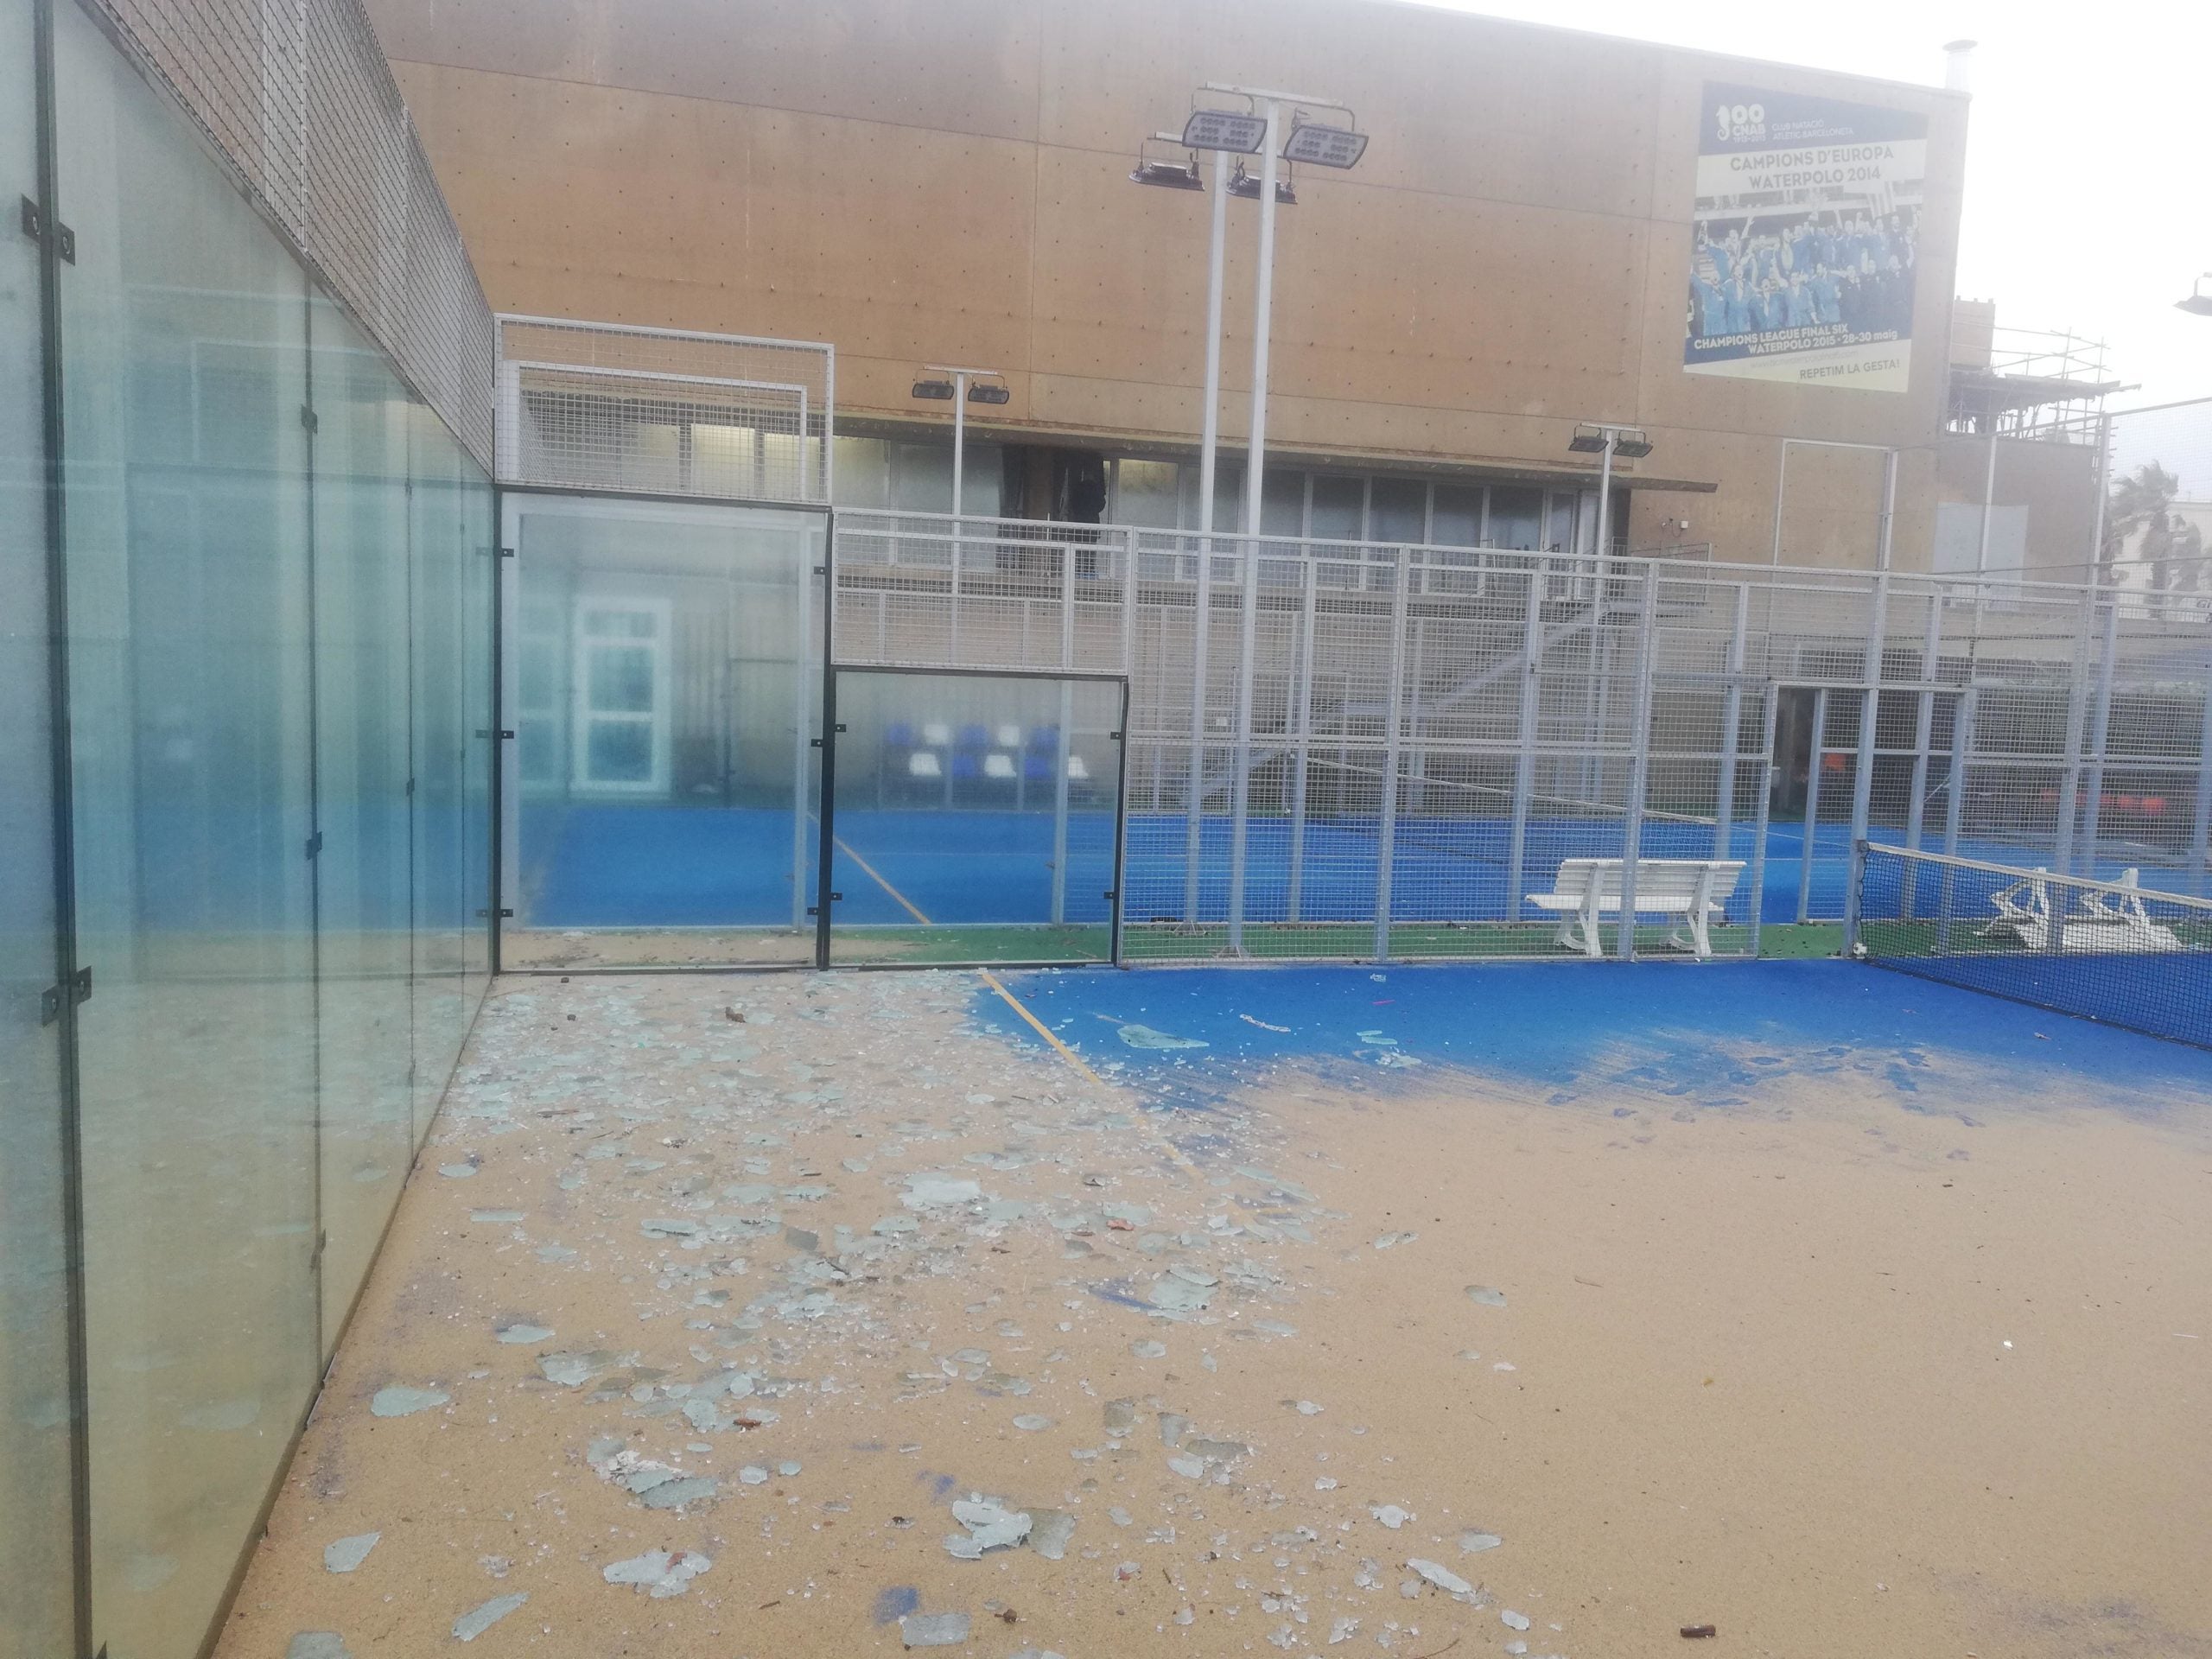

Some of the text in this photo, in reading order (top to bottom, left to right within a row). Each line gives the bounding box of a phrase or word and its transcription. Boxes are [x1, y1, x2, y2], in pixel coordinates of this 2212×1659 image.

[1732, 123, 1766, 136] CNAB
[1771, 123, 1791, 131] CLUB
[1730, 145, 1894, 171] CAMPIONS D'EUROPA
[1749, 166, 1881, 189] WATERPOLO 2014
[1694, 323, 1848, 349] CHAMPIONS LEAGUE FINAL SIX
[1748, 329, 1898, 354] WATERPOLO 2015 28-30 maig
[1800, 365, 1844, 379] REPETIM
[1847, 364, 1860, 374] LA
[1863, 359, 1900, 372] GESTA!
